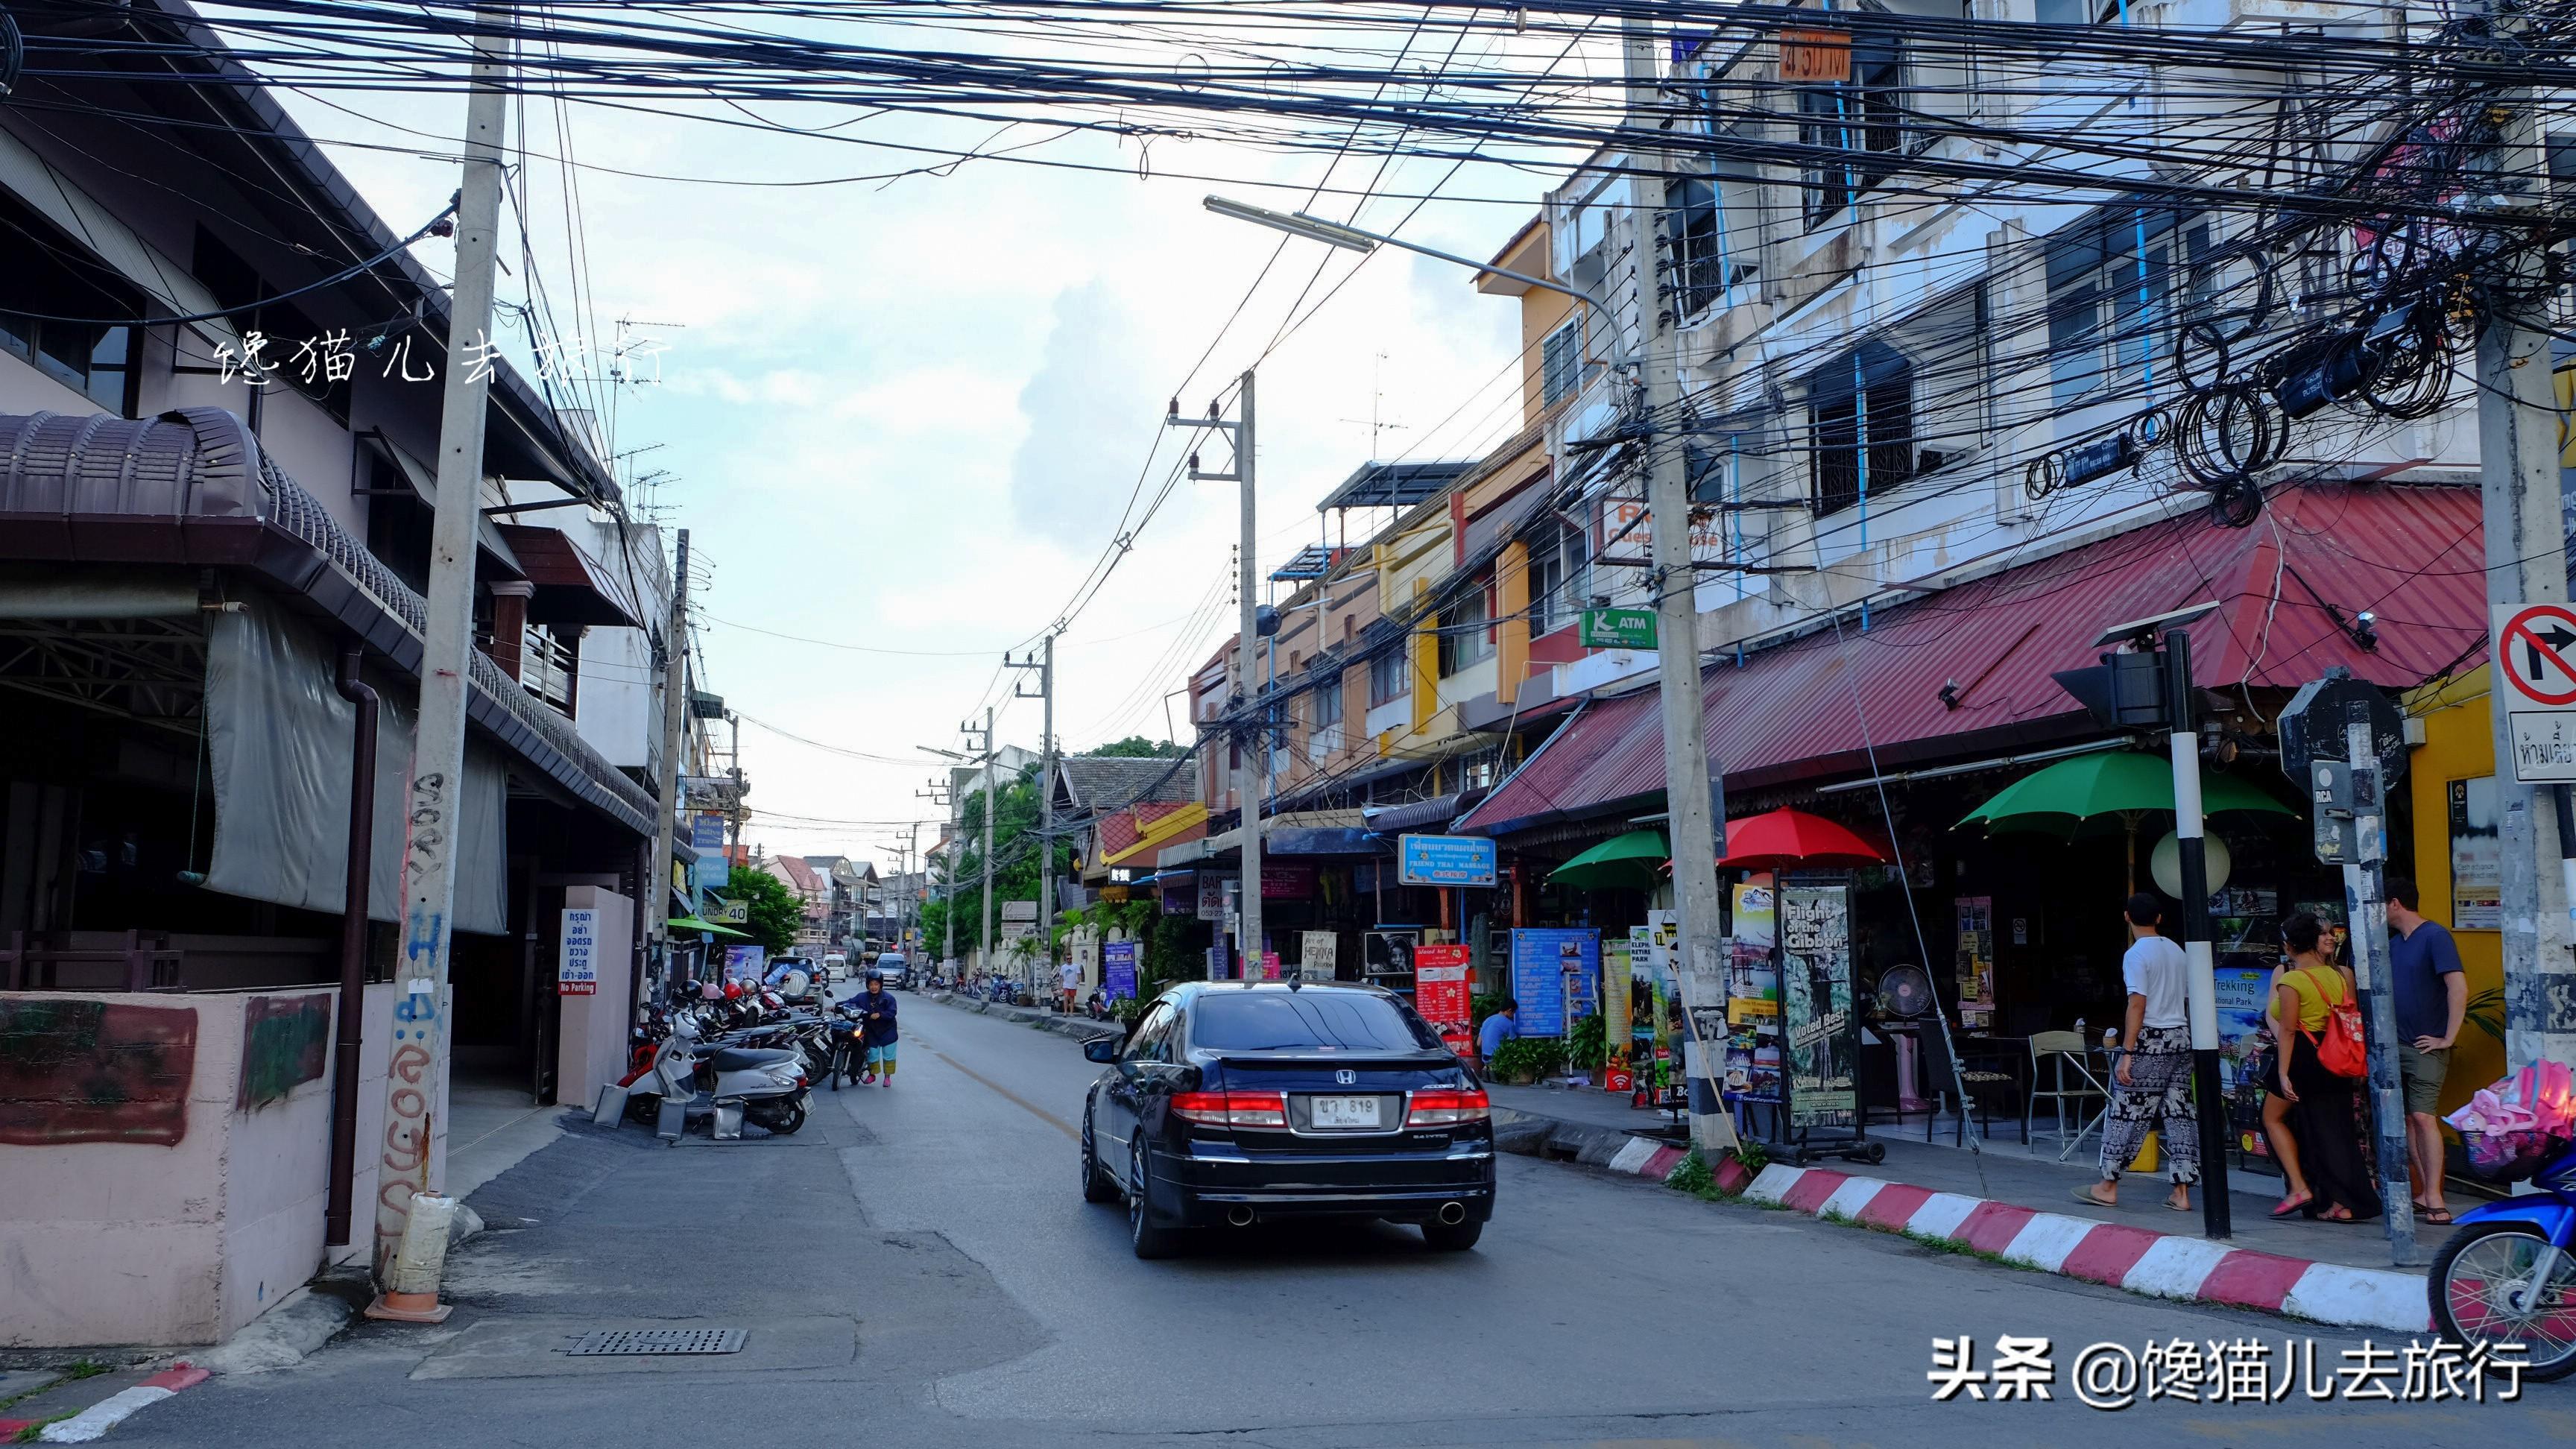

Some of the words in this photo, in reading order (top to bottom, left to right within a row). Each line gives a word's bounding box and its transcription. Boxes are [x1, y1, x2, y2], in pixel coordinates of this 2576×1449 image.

[1618, 617, 1647, 630] ATM
[2315, 790, 2332, 803] RCA
[728, 908, 745, 920] 40
[1787, 905, 1832, 922] Flight
[572, 924, 587, 934] อย่า
[1787, 922, 1799, 932] of
[1802, 921, 1821, 932] the
[1787, 933, 1843, 947] Gibbon
[1304, 947, 1333, 959] HENNA
[561, 983, 569, 991] No
[571, 983, 594, 994] Parking
[2214, 978, 2255, 995] Trekking
[2214, 997, 2234, 1006] ational
[2236, 997, 2252, 1006] Park
[1795, 1016, 1822, 1038] Voted
[1823, 1007, 1845, 1026] Best
[1795, 1032, 1819, 1046] Attraction
[1825, 1020, 1845, 1035] Thailand
[1349, 1099, 1373, 1113] 819
